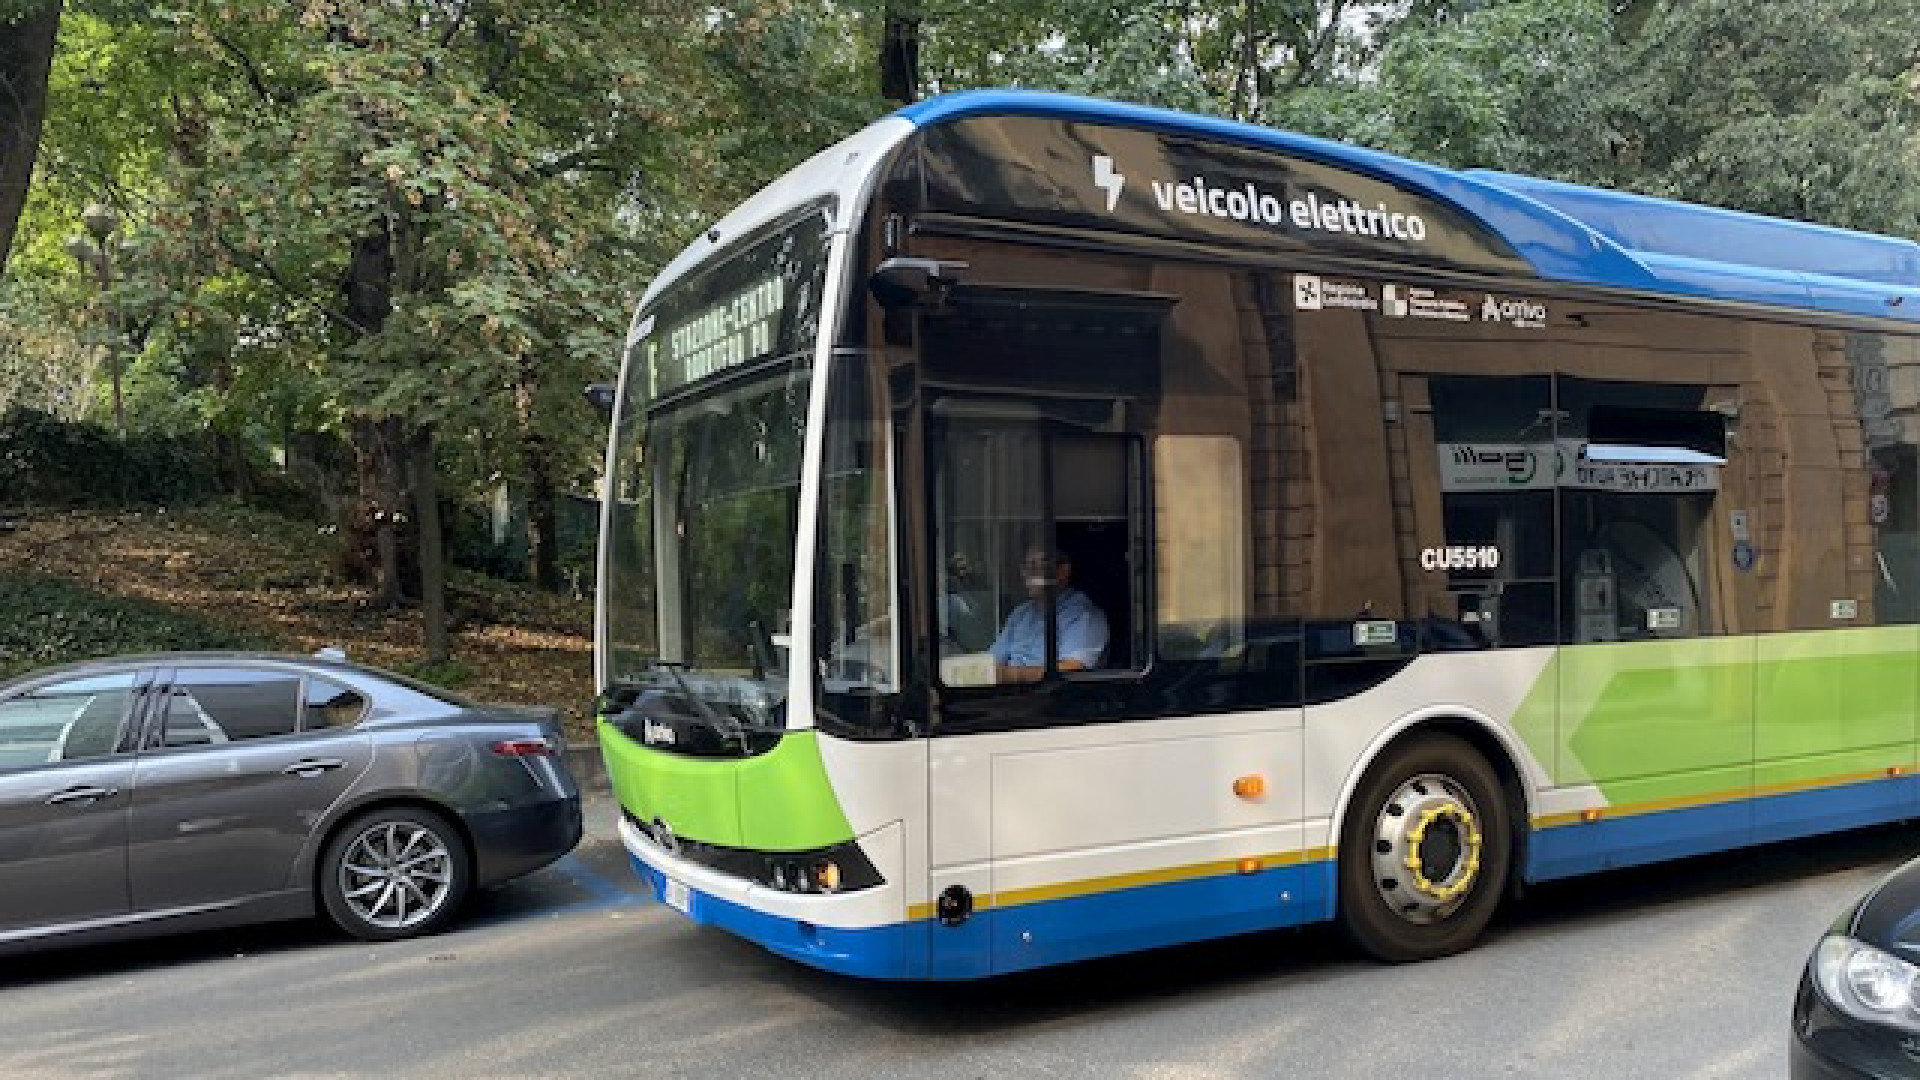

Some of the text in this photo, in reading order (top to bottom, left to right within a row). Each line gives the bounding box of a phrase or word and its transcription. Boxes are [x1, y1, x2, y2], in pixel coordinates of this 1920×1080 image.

[1152, 175, 1426, 241] veicolo elettrico
[1421, 545, 1498, 570] CU5510
